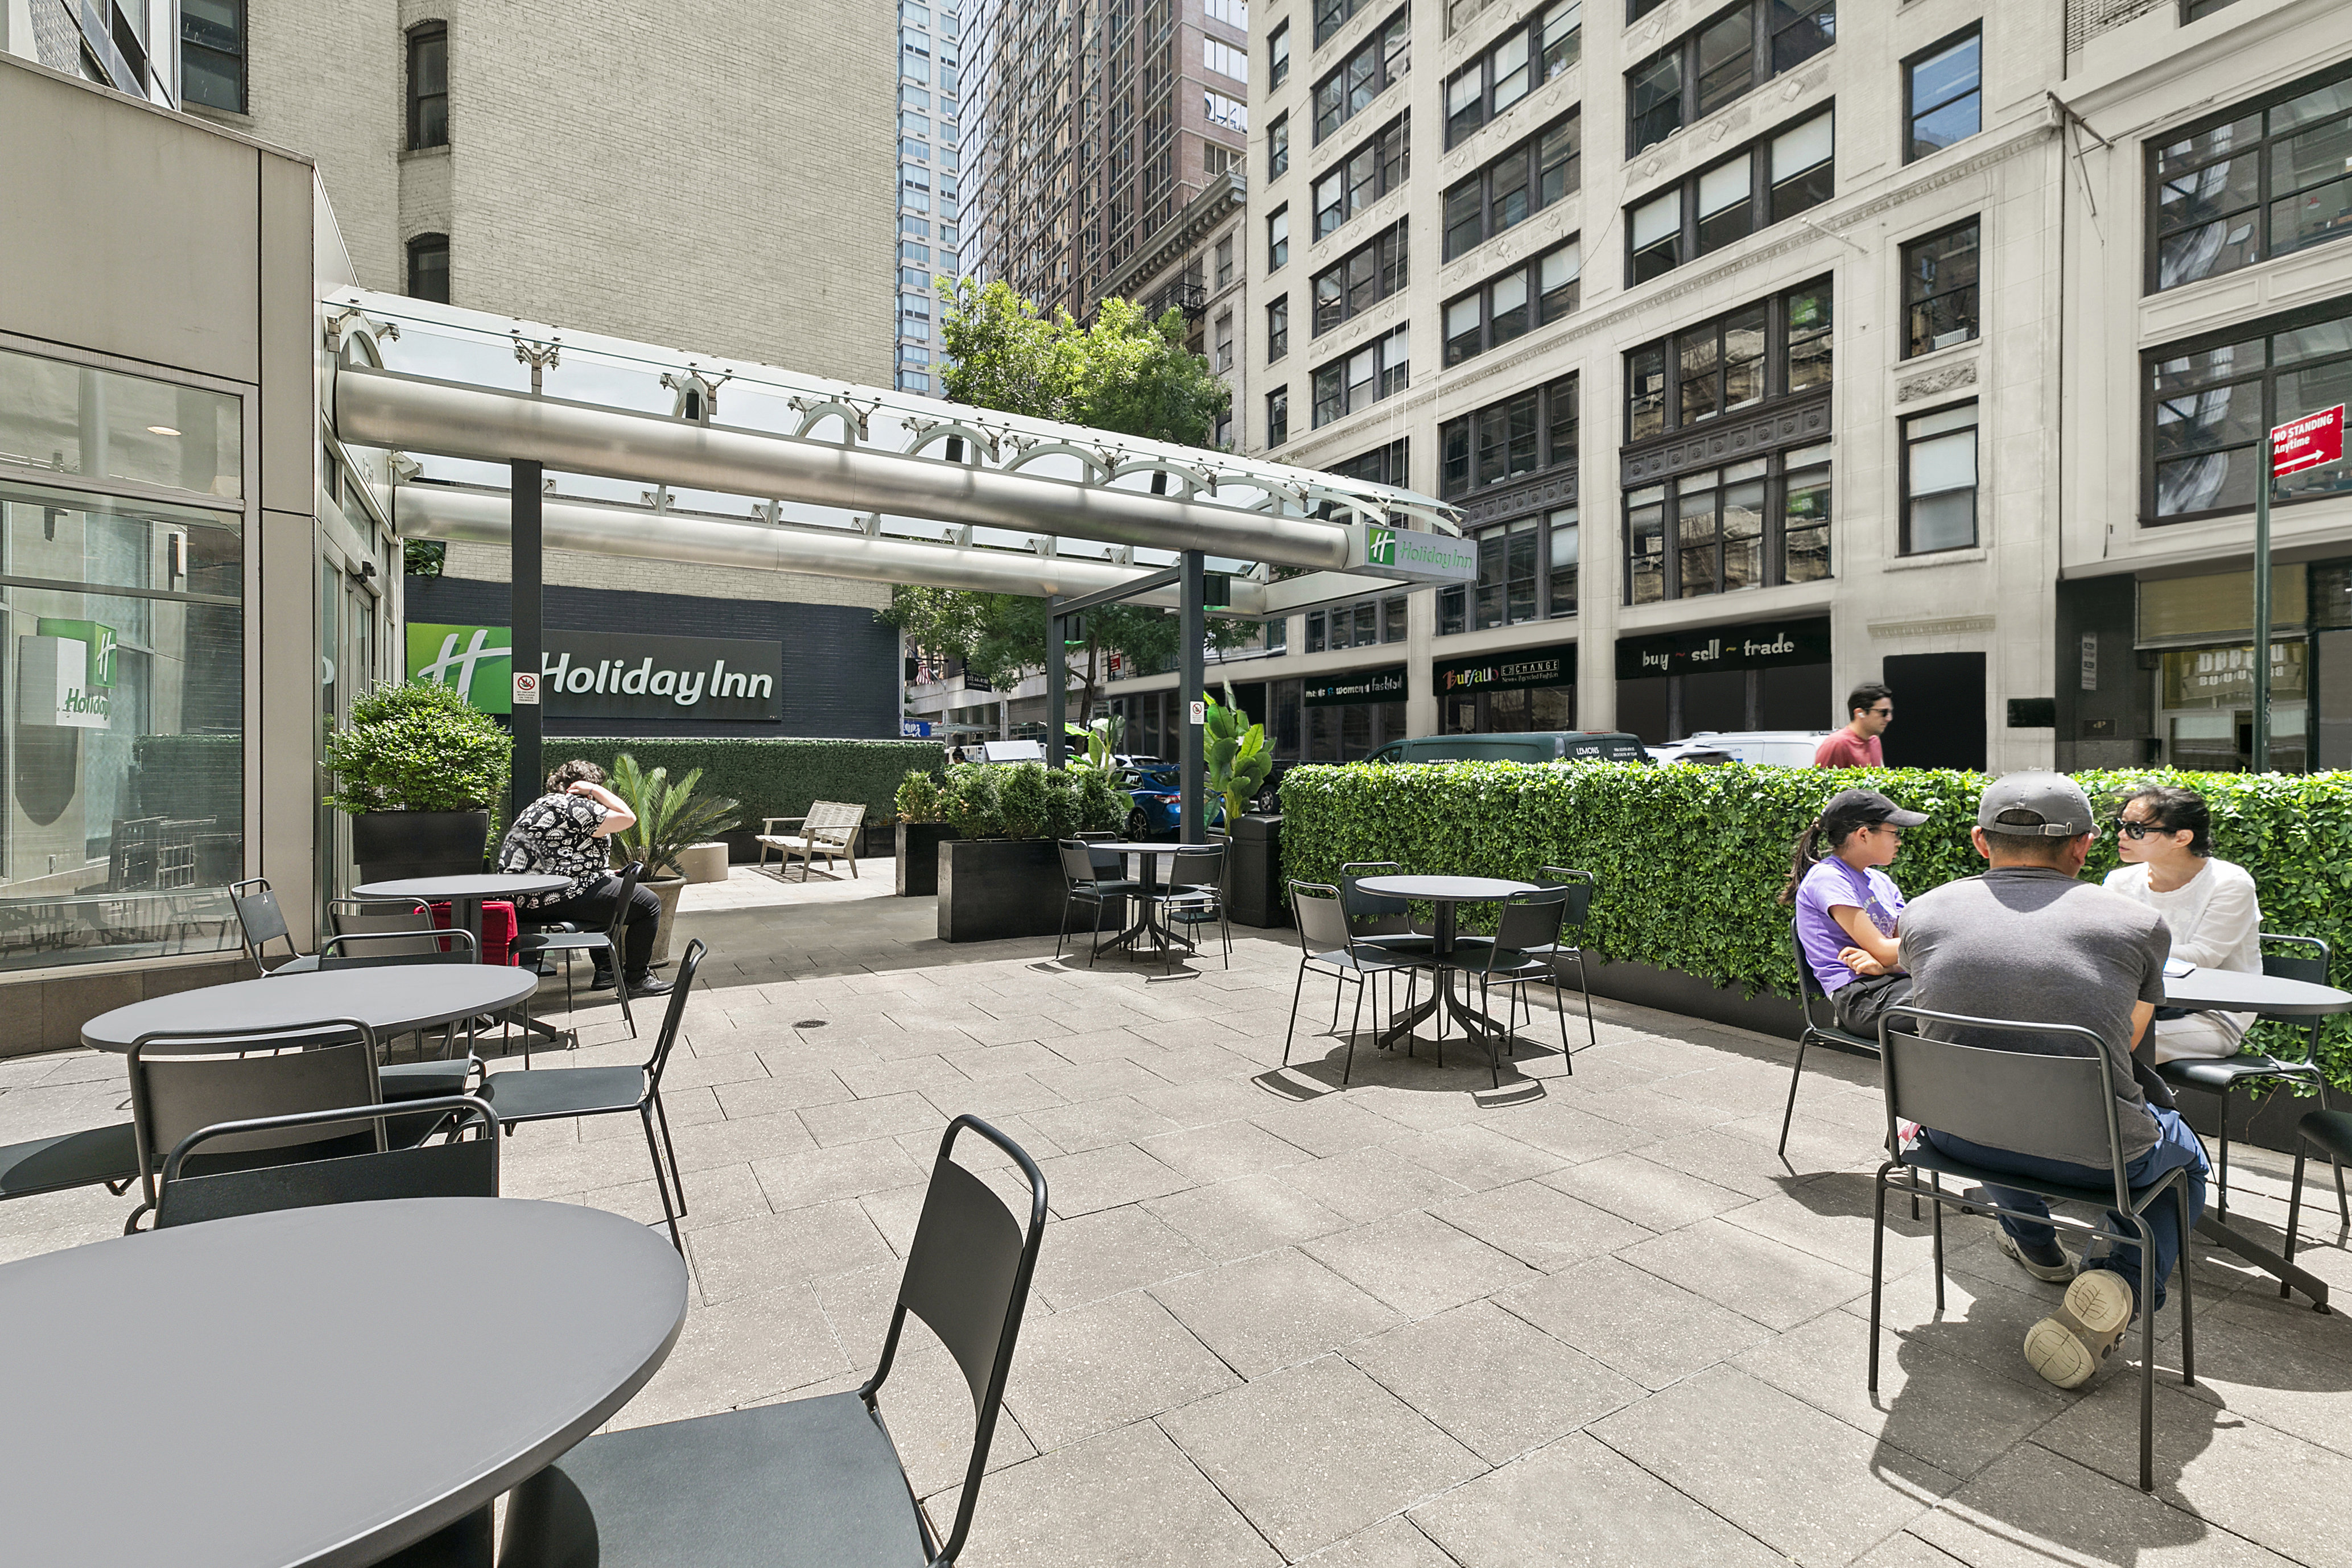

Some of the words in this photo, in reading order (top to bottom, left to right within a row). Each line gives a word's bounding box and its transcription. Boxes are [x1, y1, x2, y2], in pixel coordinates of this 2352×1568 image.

[2273, 430, 2287, 443] NO
[2288, 414, 2334, 438] STANDING
[2273, 436, 2310, 455] Anytime
[1400, 541, 1451, 569] Holiday
[1453, 549, 1472, 569] Inn
[1642, 650, 1669, 671] buy
[1691, 638, 1720, 661] sell
[1743, 632, 1795, 657] trade
[542, 651, 705, 705] Holiday
[710, 659, 773, 699] Inn
[1502, 660, 1558, 674] EXCHANGE
[1576, 746, 1599, 755] LEMONS
